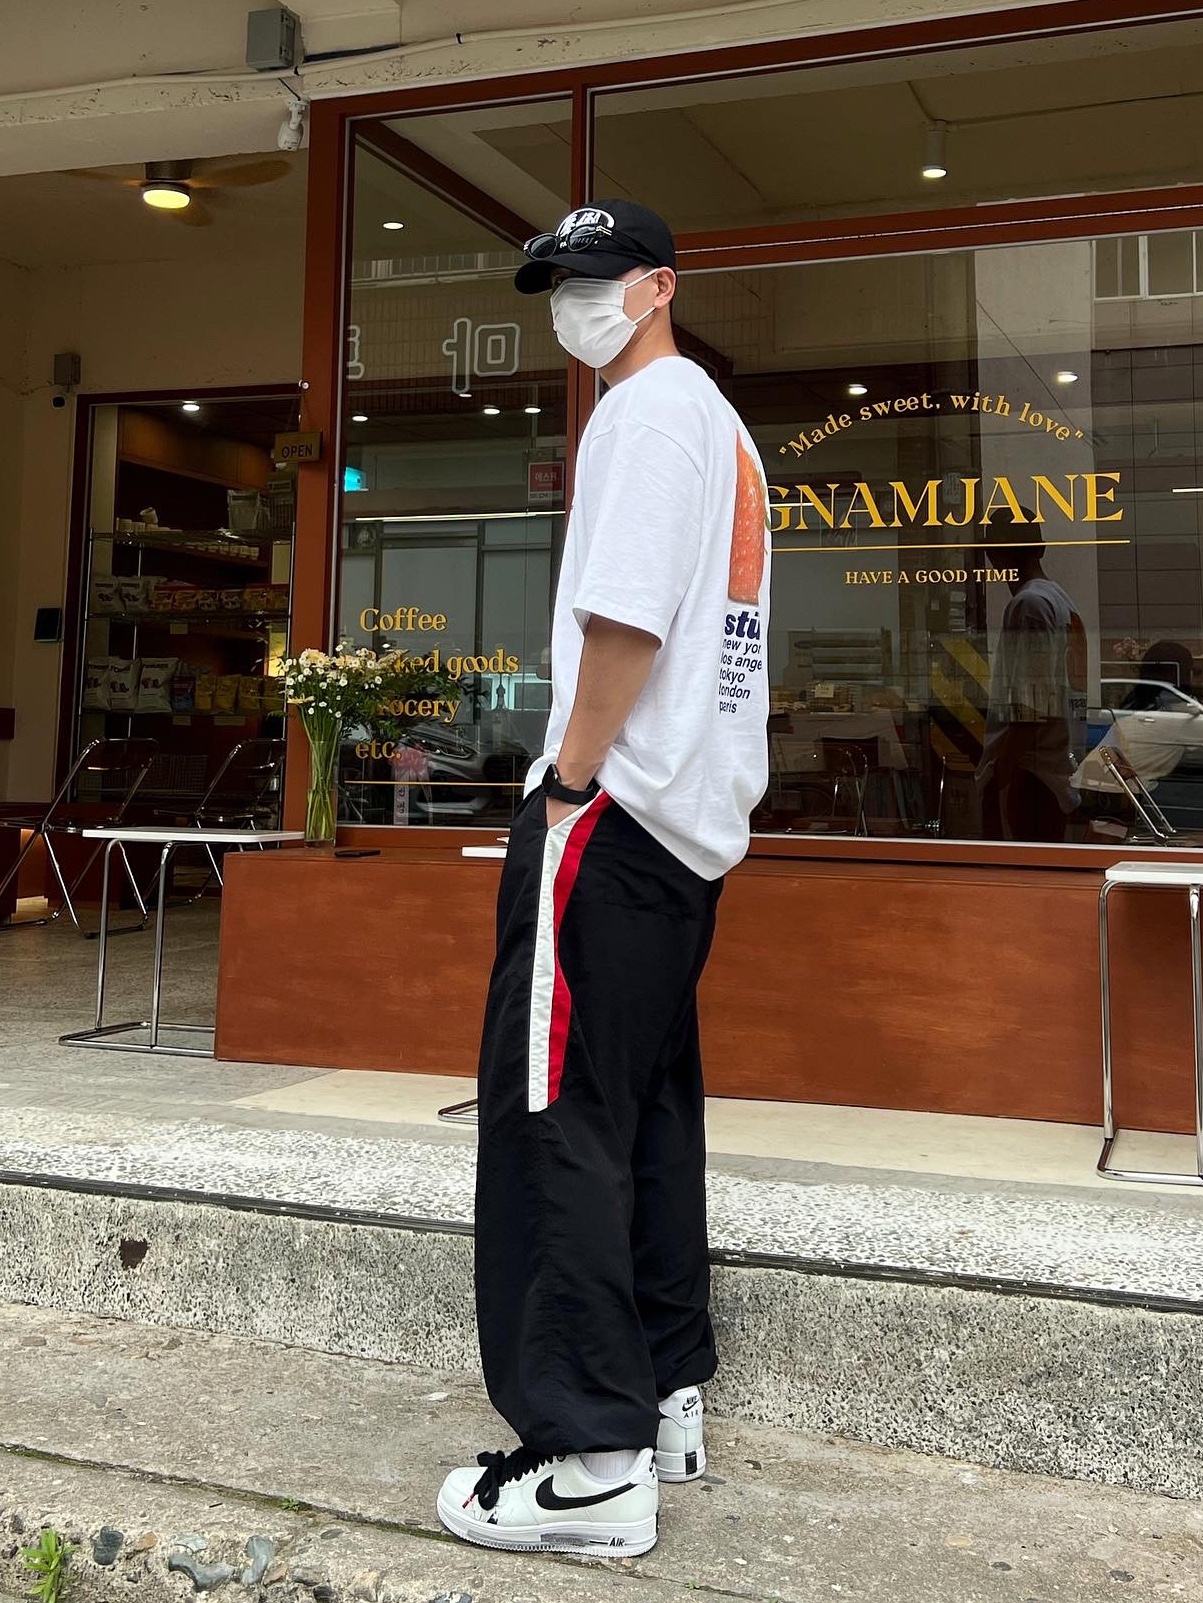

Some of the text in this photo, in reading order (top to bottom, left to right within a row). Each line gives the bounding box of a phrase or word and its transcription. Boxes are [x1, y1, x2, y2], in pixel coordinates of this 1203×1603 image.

[778, 413, 852, 458] "Made
[950, 391, 1011, 418] with
[1017, 402, 1084, 442] love"
[281, 443, 313, 459] OPEN
[768, 472, 1124, 532] GNAMJANE
[845, 568, 1020, 585] HAVE A GOOD TIME
[360, 606, 447, 632] Coffee
[722, 638, 741, 651] new
[446, 649, 519, 681] goods
[720, 650, 733, 666] los
[719, 668, 746, 685] tokyo
[718, 682, 751, 700] london
[718, 699, 738, 714] paris
[355, 739, 402, 760] etc.
[609, 1537, 625, 1547] AIR
